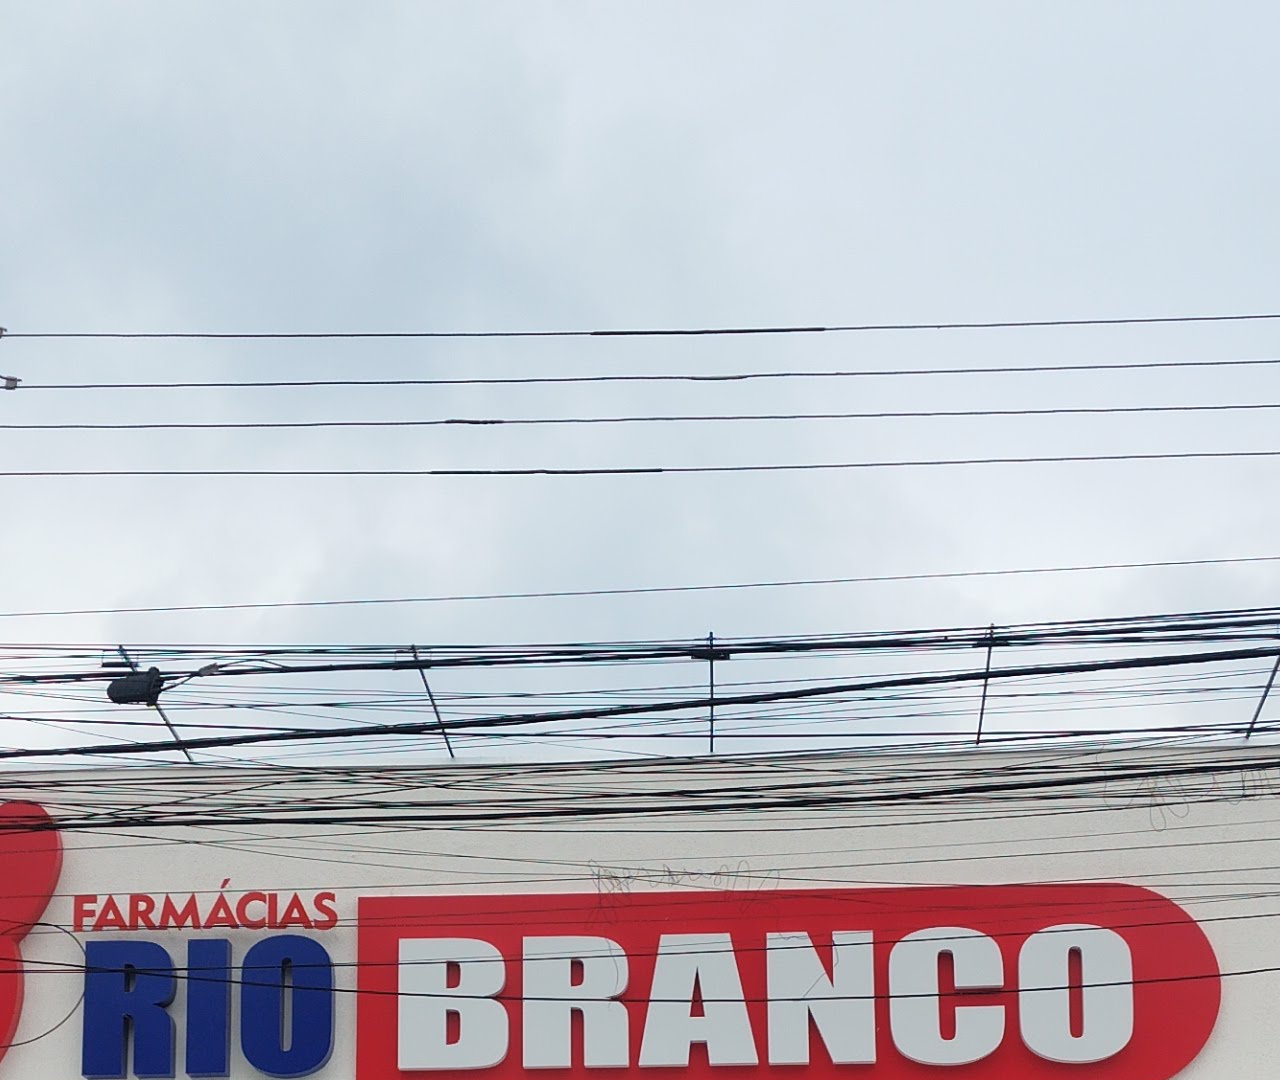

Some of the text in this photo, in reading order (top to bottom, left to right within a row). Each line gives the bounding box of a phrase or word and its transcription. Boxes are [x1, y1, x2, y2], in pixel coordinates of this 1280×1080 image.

[73, 877, 341, 933] FARMÁCIAS
[79, 923, 1136, 1080] RIO BRANCO
